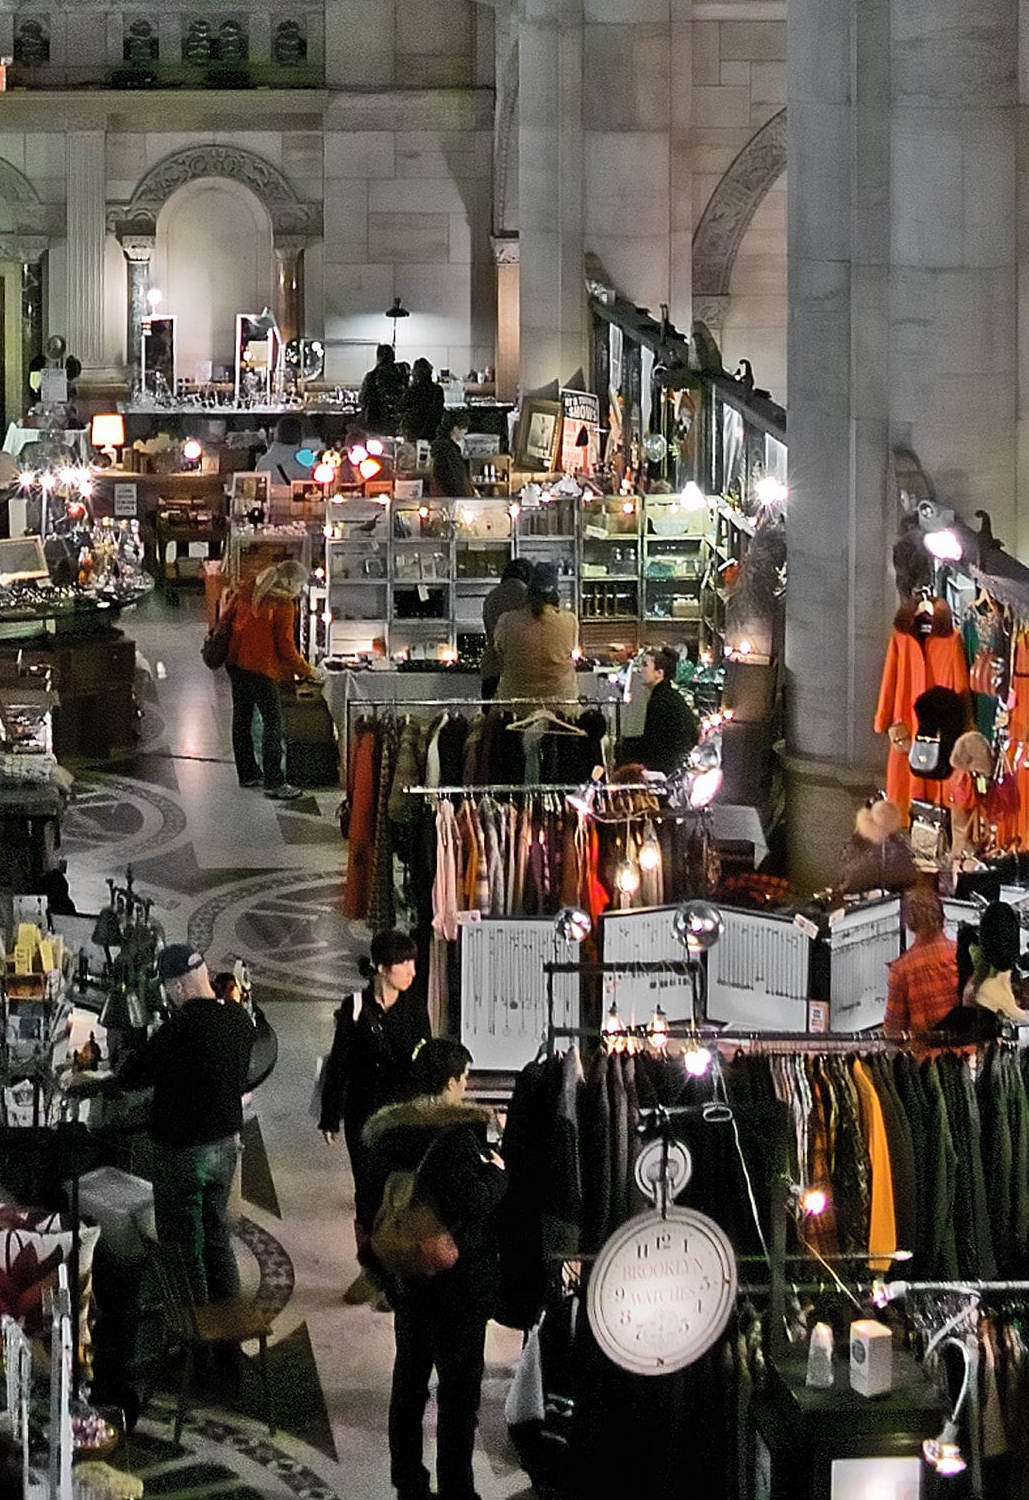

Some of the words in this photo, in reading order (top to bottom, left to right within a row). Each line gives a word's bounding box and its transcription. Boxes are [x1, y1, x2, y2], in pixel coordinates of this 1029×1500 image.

[656, 1233, 671, 1250] 12
[637, 1244, 648, 1259] 11
[623, 1258, 703, 1281] BROOKLYN
[630, 1285, 696, 1306] WATCHES
